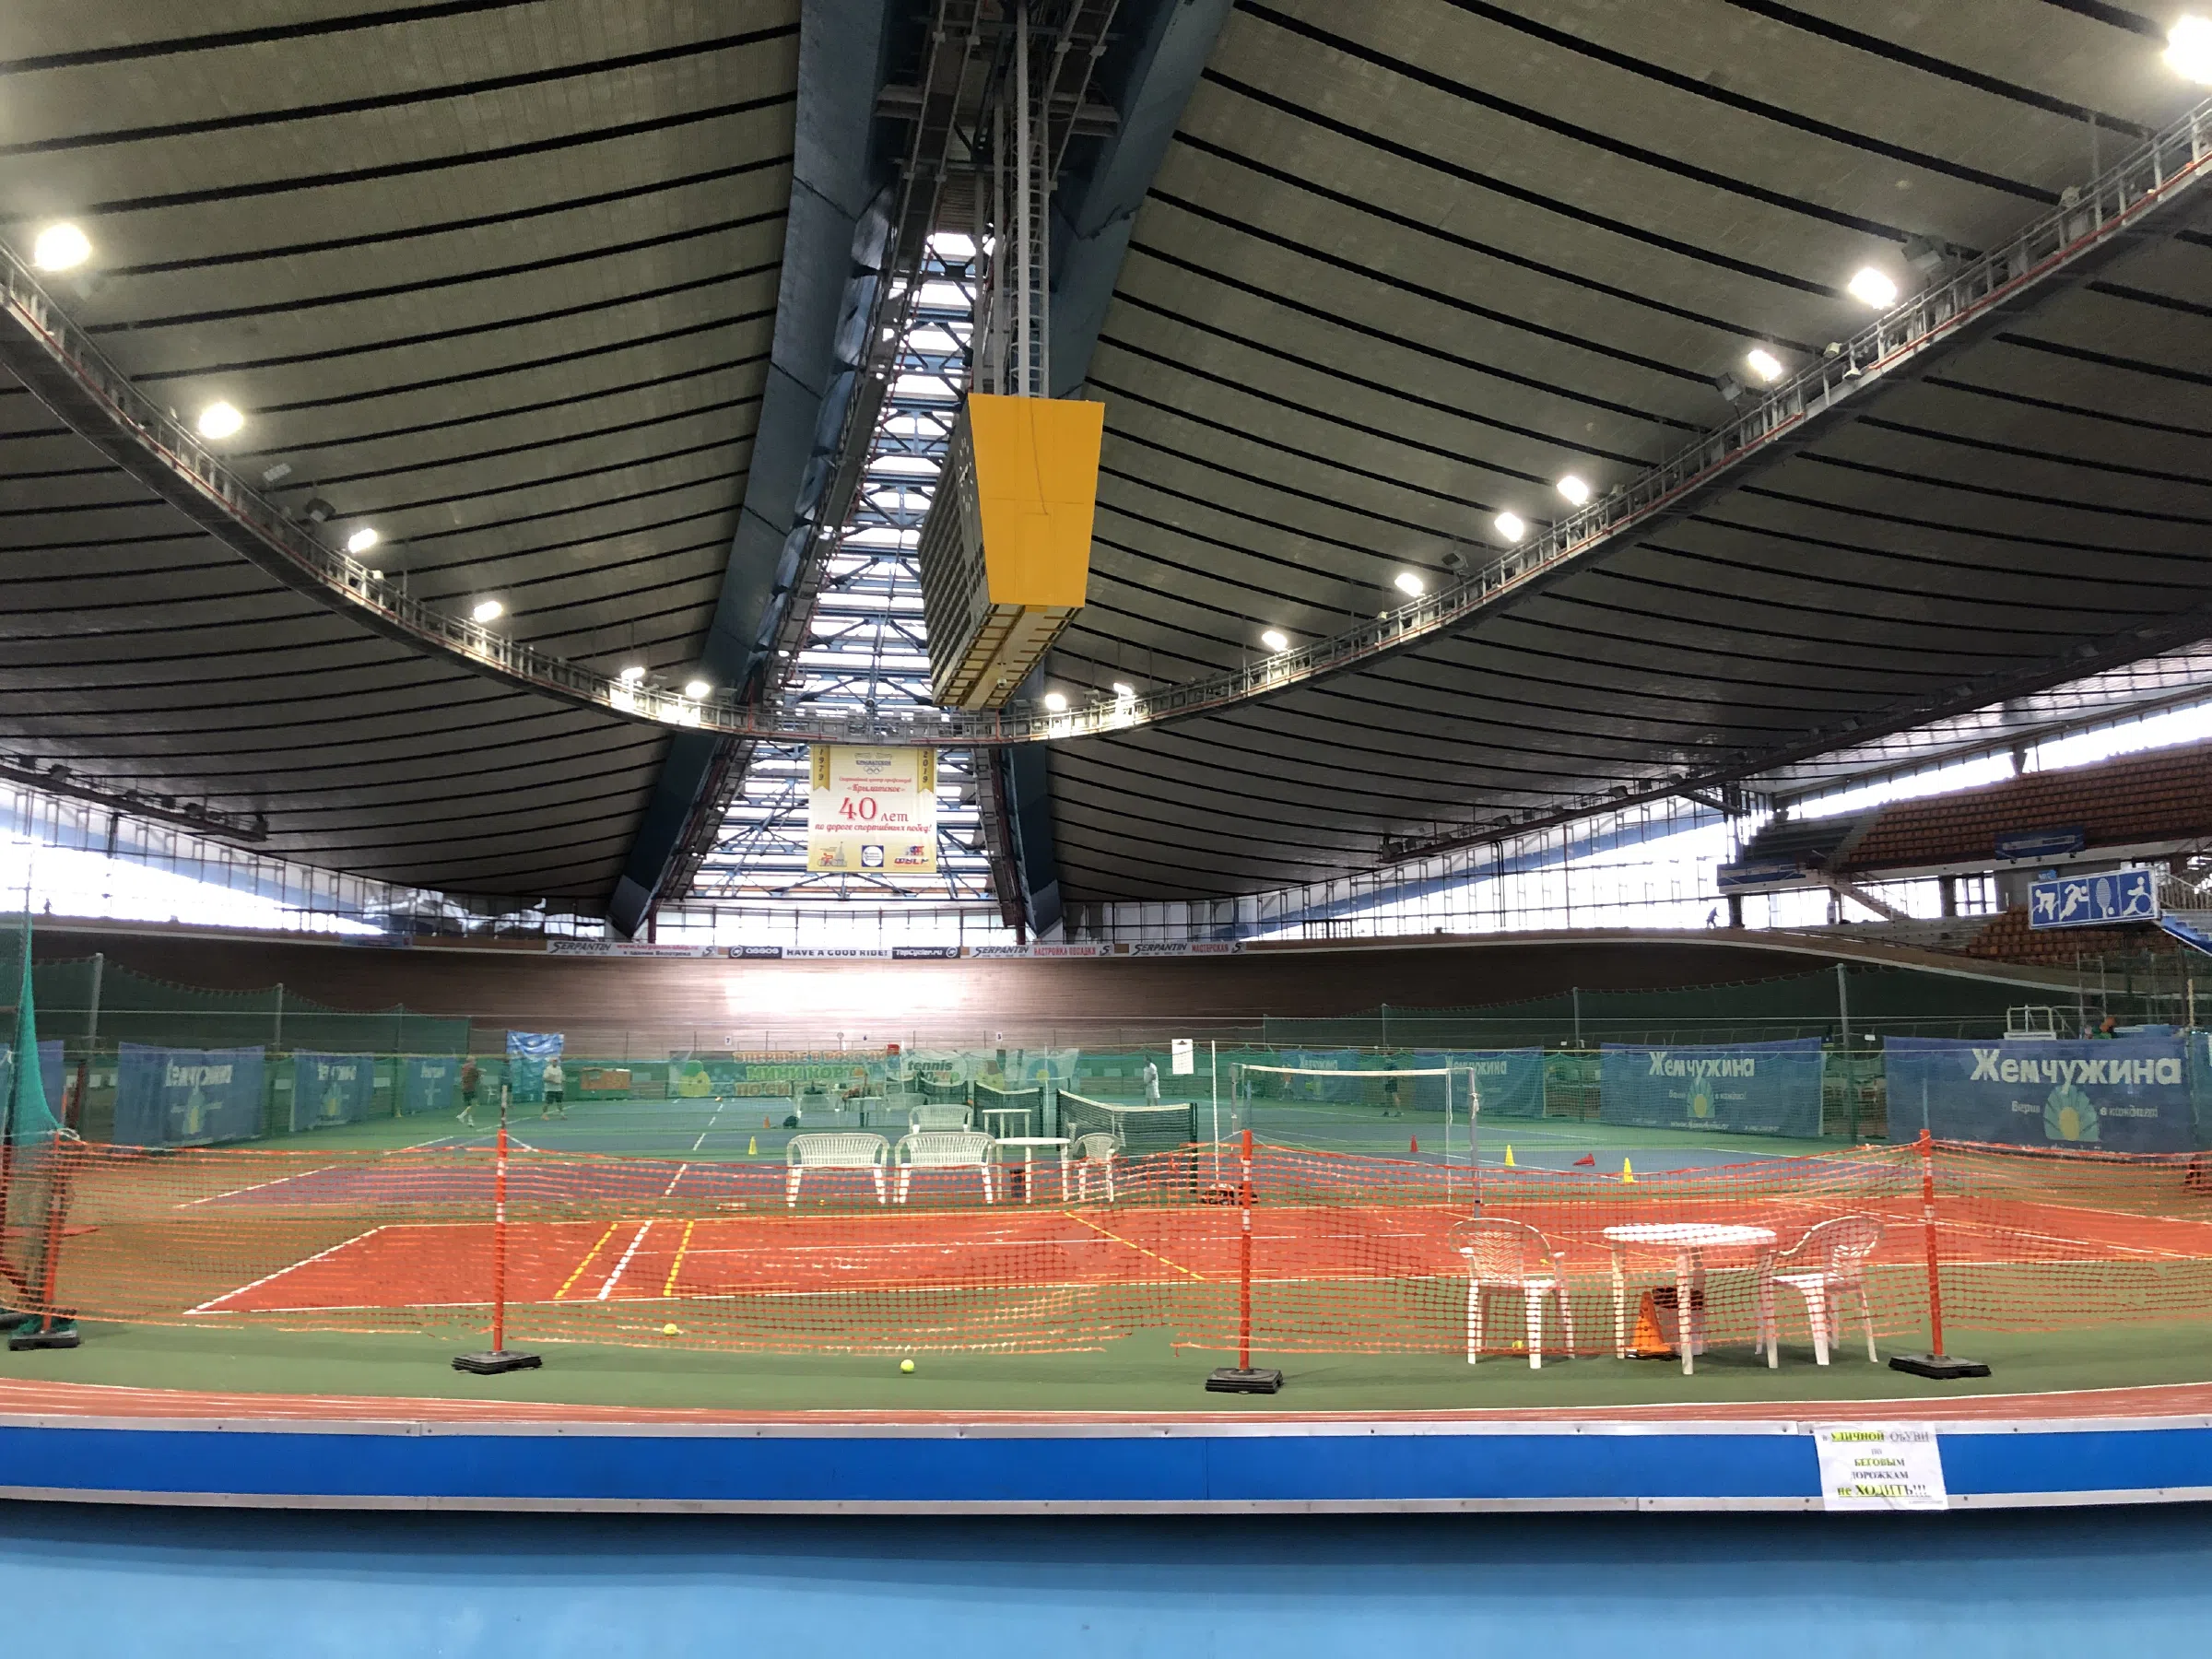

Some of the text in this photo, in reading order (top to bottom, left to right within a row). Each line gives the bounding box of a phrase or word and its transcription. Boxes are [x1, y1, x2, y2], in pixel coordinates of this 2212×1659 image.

[839, 797, 909, 822] 40 лет
[826, 823, 853, 832] дороге
[853, 823, 905, 833] спортивных
[549, 942, 612, 954] SERPANTIN
[971, 946, 1030, 958] SERPANTIN
[1132, 943, 1187, 956] SERPANTIN
[1192, 944, 1229, 953] МАСТЕРСКАЯ
[908, 1060, 953, 1071] tennis
[1649, 1052, 1756, 1085] Жемчужина
[1970, 1048, 2182, 1095] Жемчужина
[746, 1065, 804, 1081] МИНИ
[1830, 1430, 1885, 1441] УЛИЧНОЙ
[1889, 1431, 1929, 1441] ОБУВИ
[1854, 1458, 1905, 1466] БЕГОВЫМ
[1837, 1484, 1927, 1497] не ХОДИТЬ!!!
